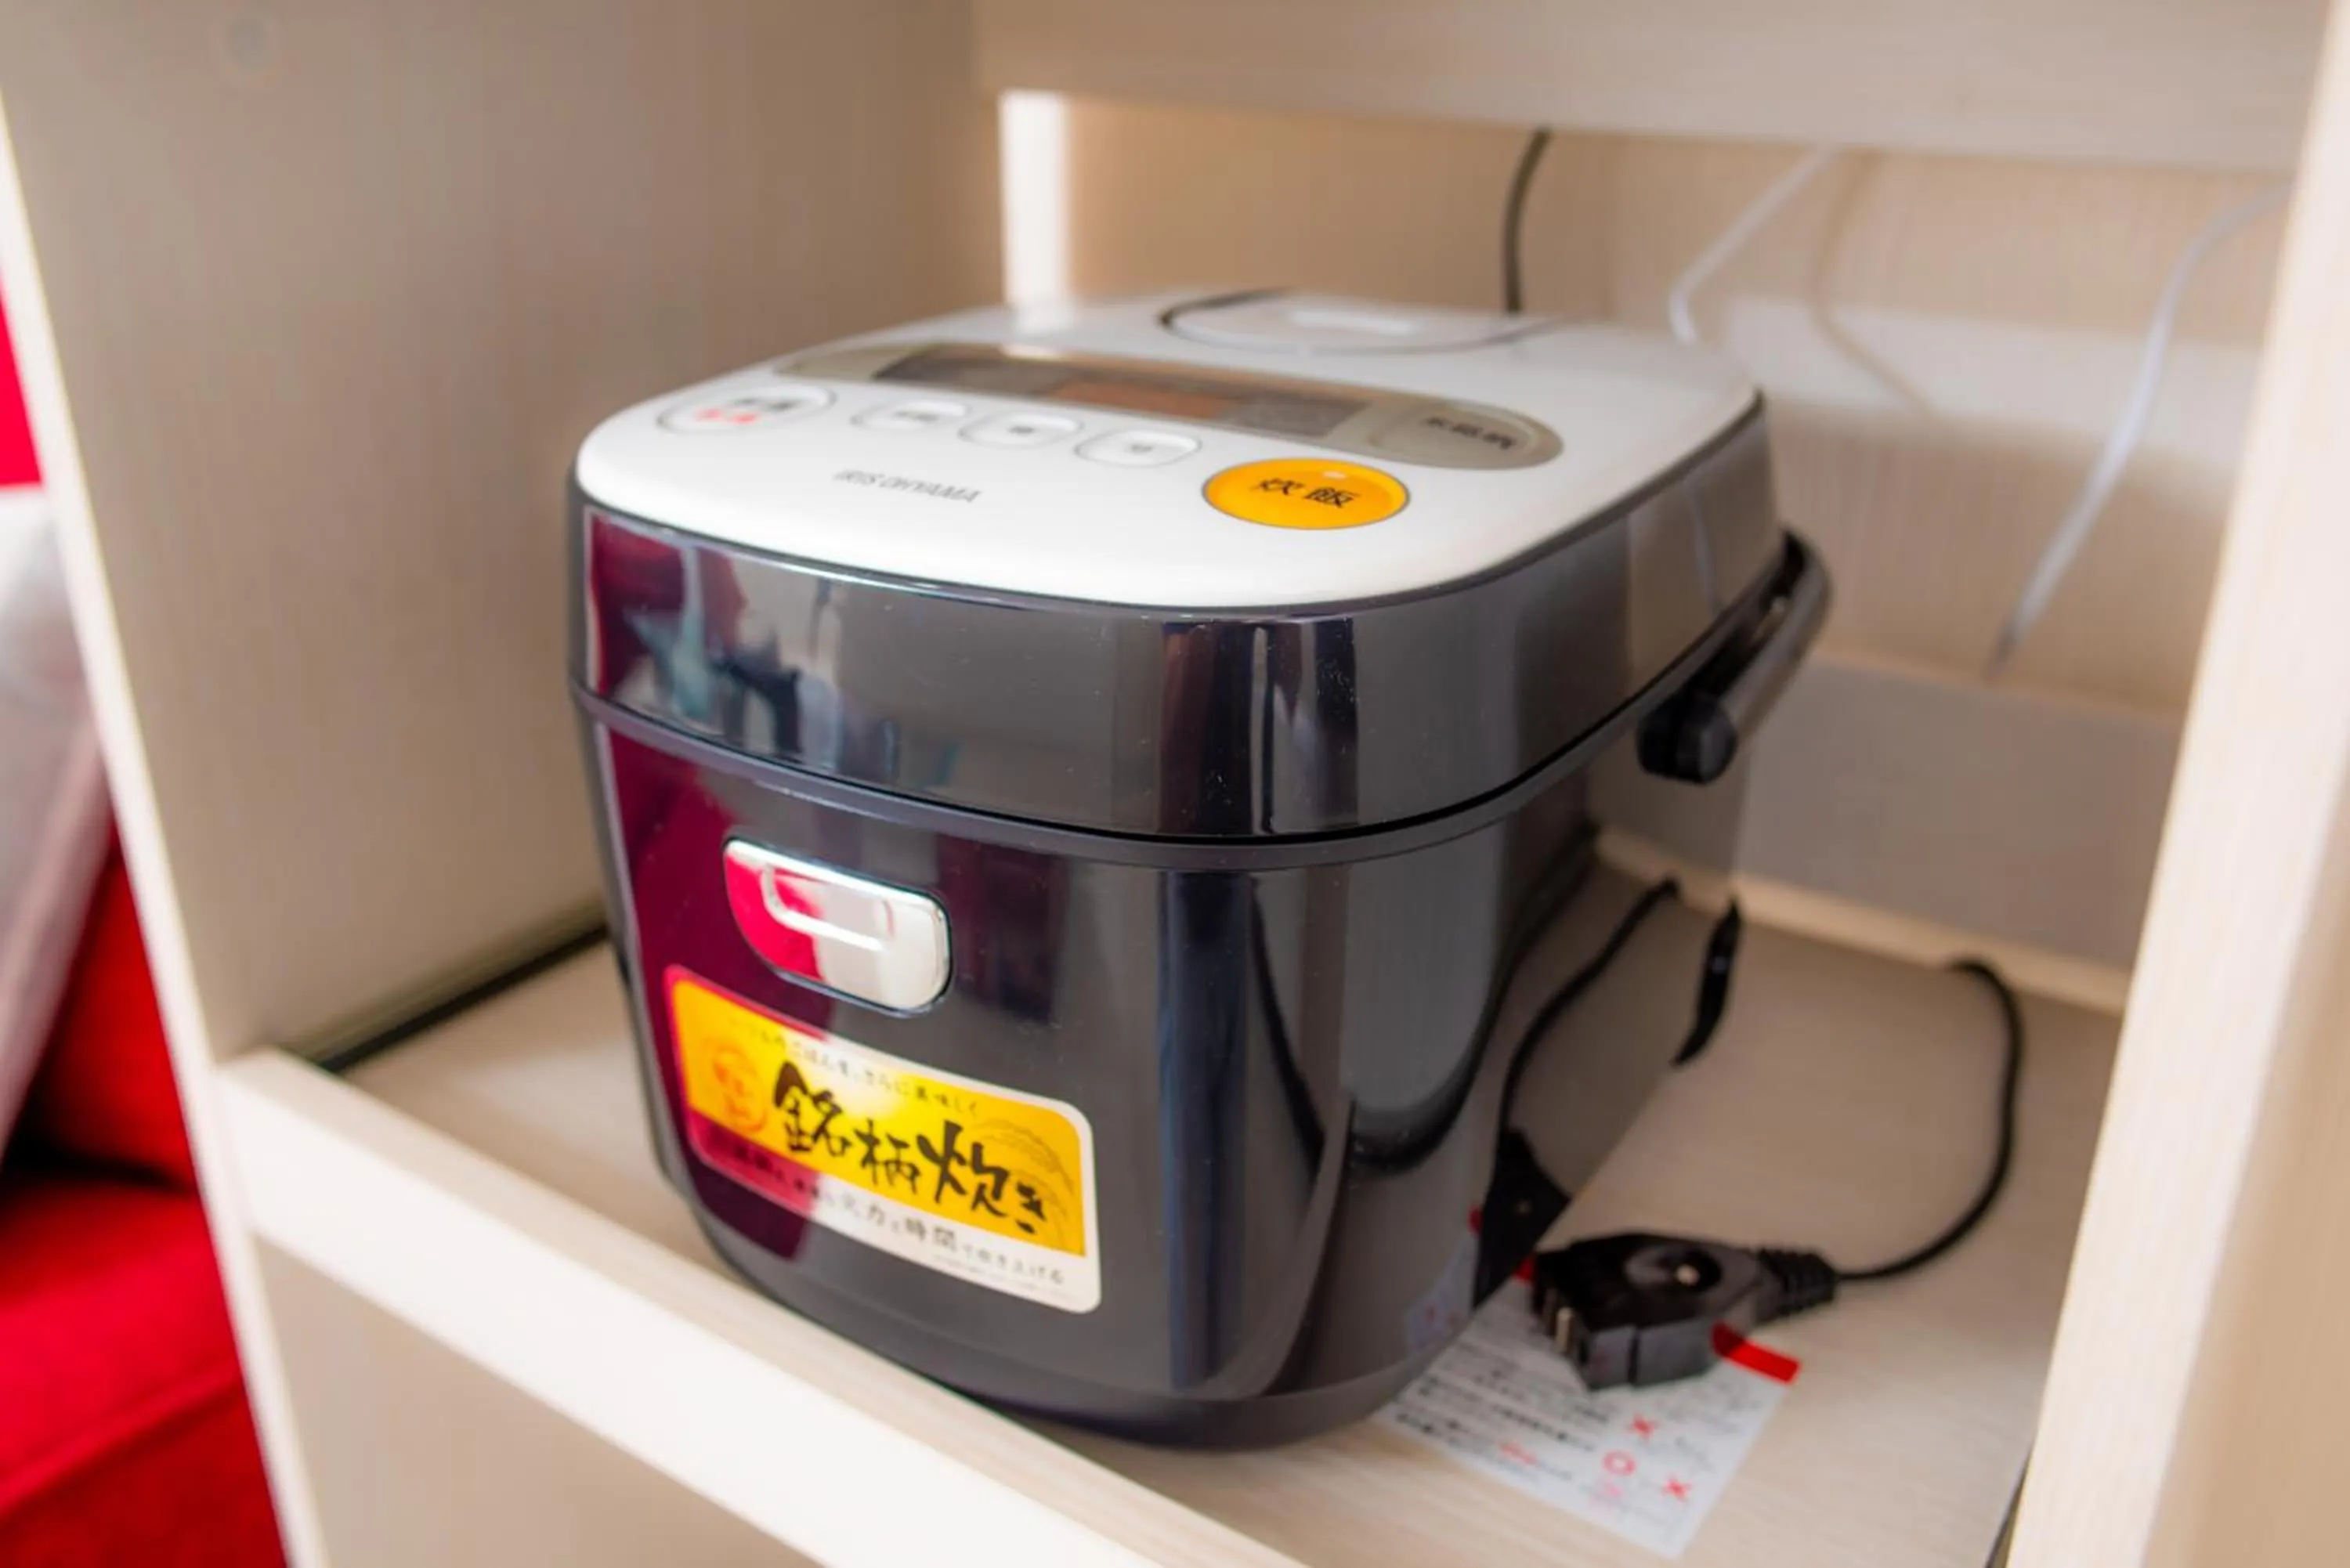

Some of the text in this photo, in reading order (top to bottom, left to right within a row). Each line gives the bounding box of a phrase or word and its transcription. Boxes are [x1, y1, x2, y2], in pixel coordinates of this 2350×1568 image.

[831, 469, 982, 504] IRIS OHYAMA
[1249, 478, 1361, 509] 炊飯
[773, 1061, 1046, 1234] 銘柄炊き
